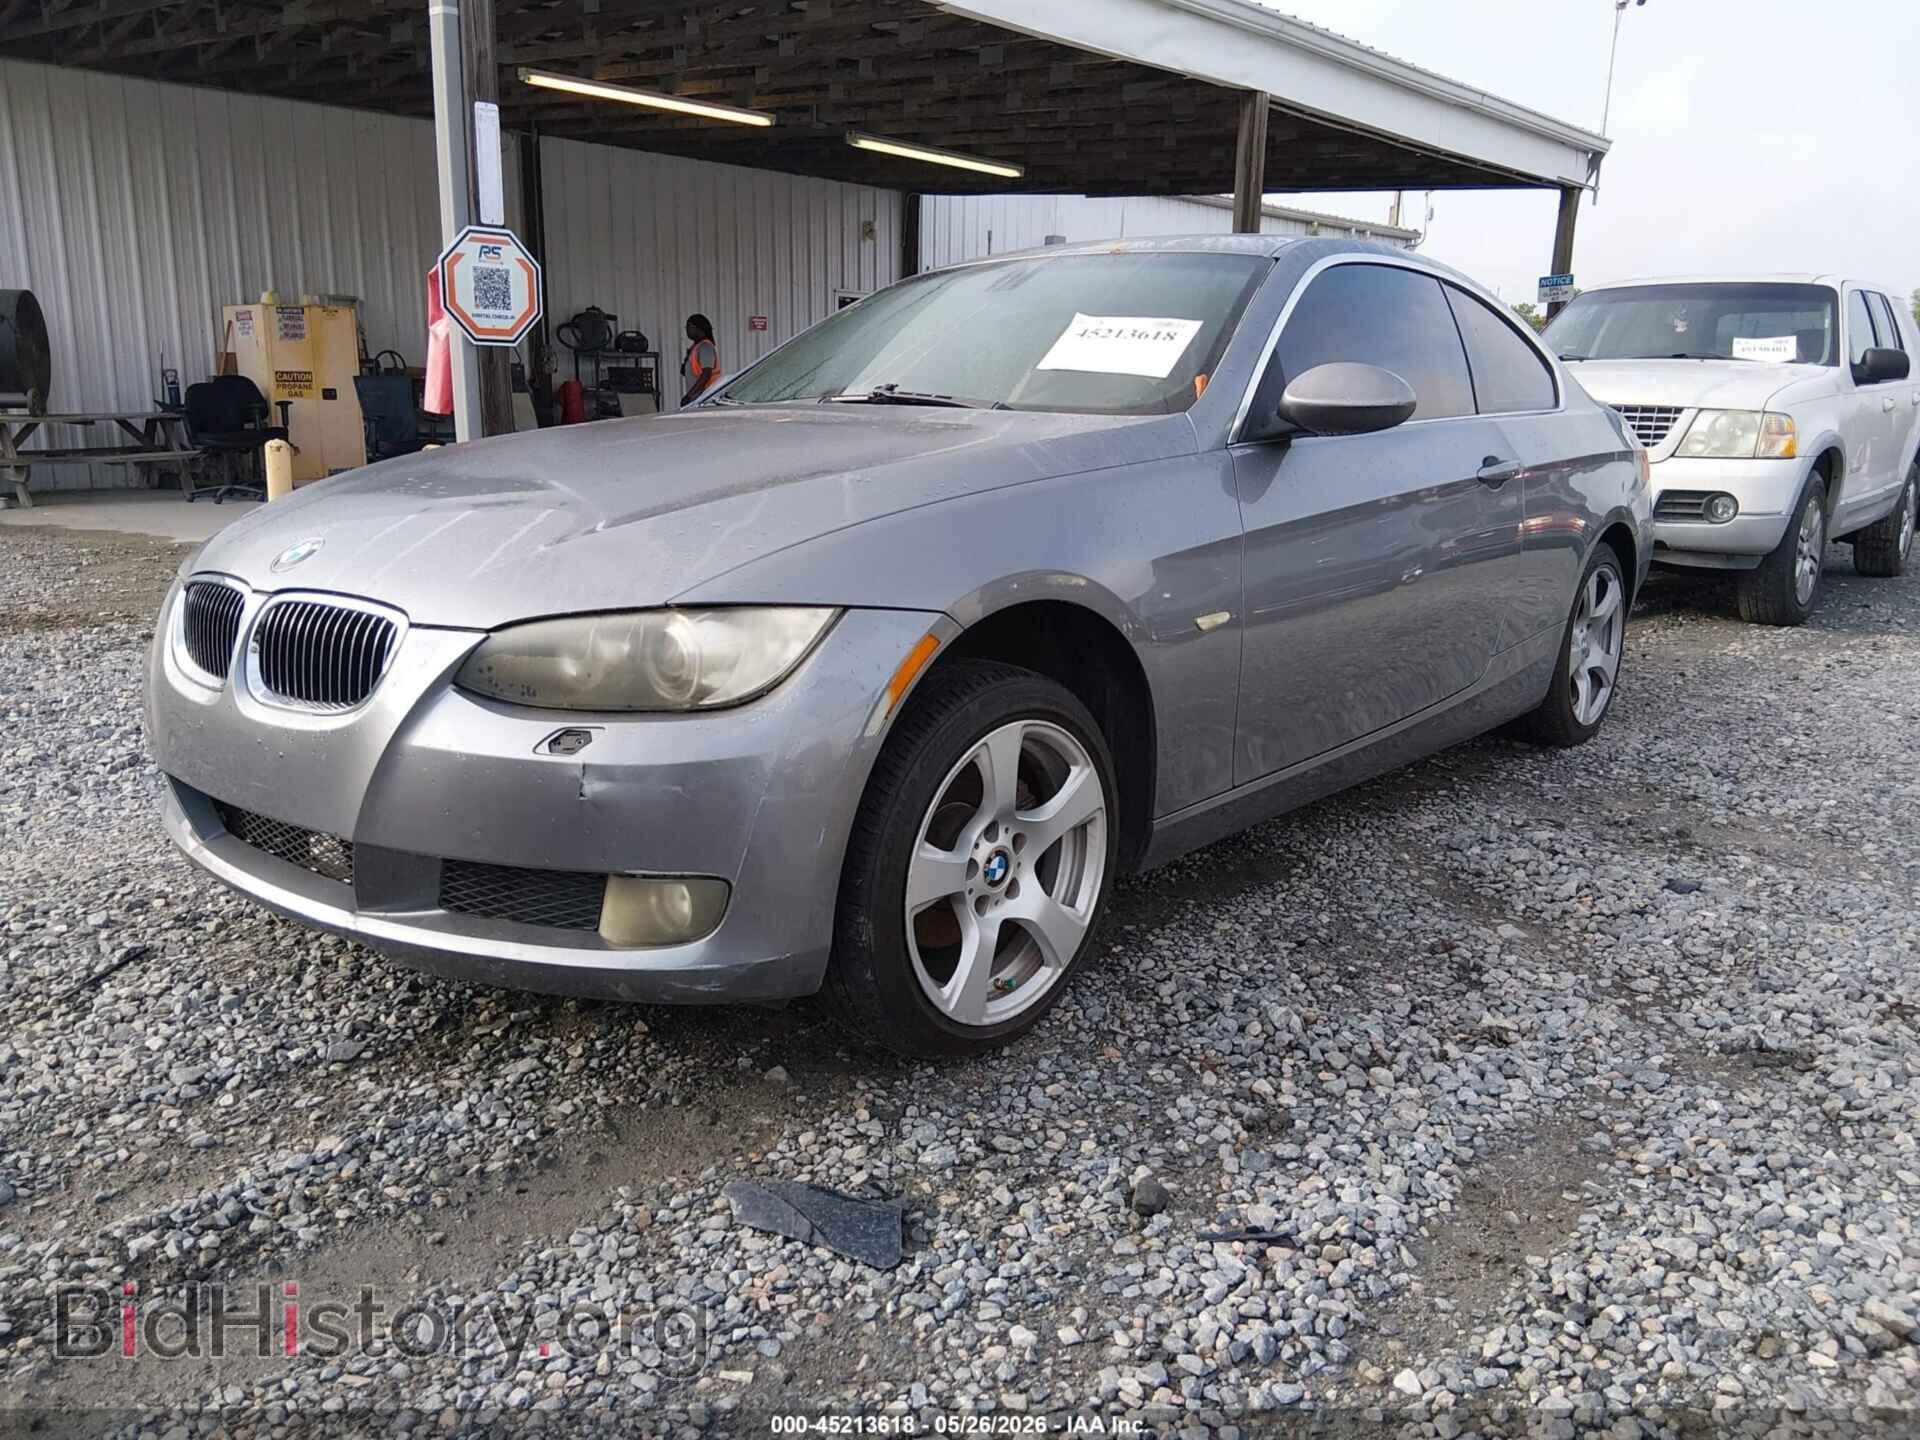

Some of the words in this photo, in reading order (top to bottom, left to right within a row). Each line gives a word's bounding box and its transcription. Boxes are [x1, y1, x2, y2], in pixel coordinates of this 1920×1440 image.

[1541, 277, 1571, 286] NOTICE
[1077, 328, 1178, 341] 45213618
[276, 372, 312, 381] CAUTION
